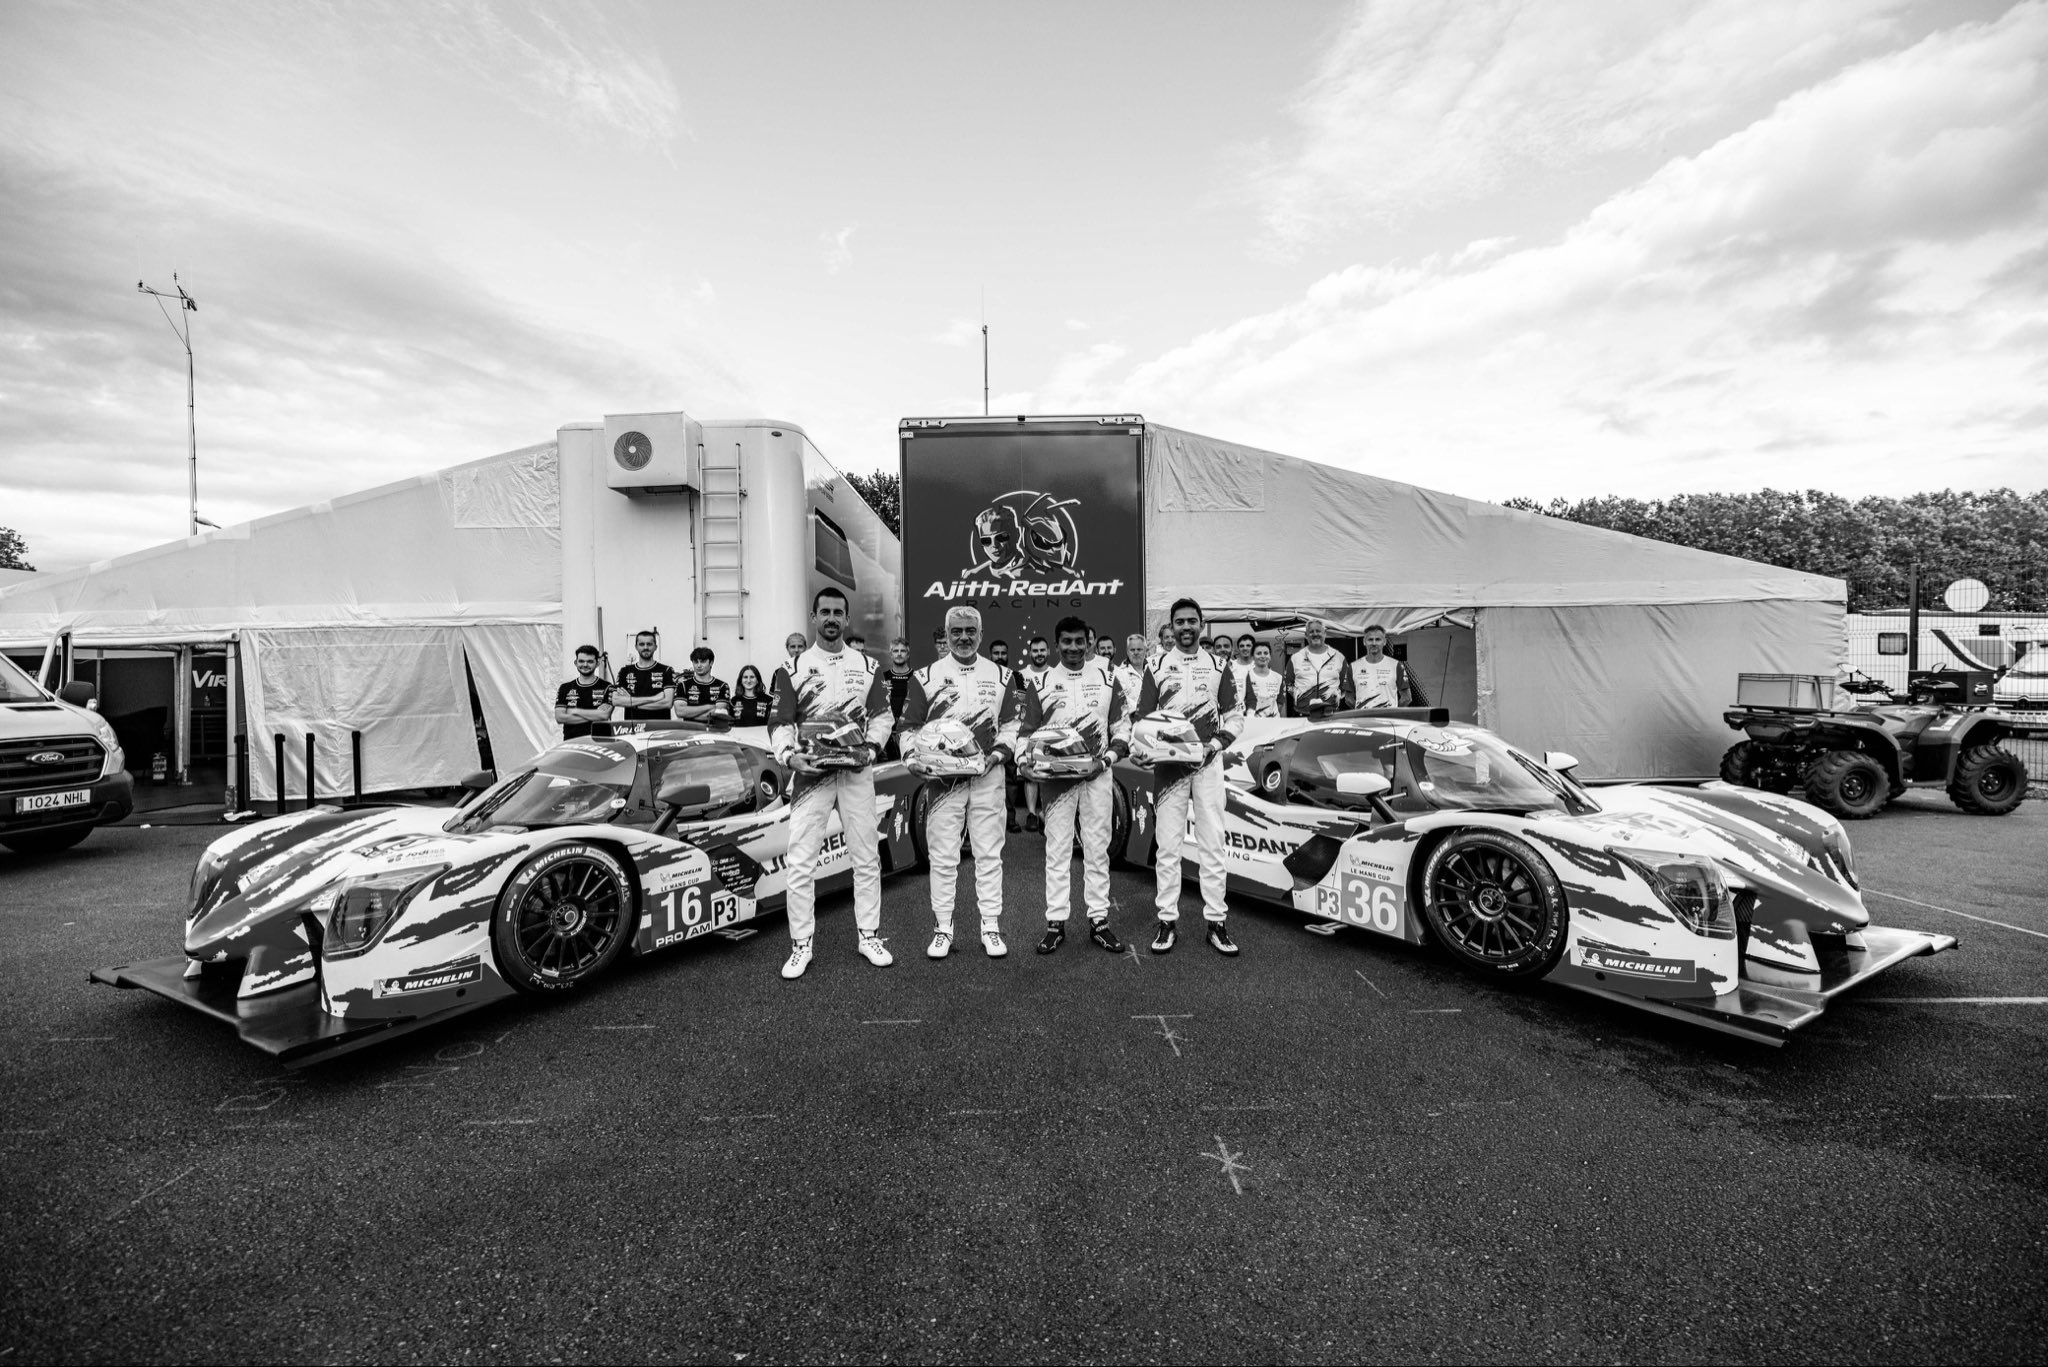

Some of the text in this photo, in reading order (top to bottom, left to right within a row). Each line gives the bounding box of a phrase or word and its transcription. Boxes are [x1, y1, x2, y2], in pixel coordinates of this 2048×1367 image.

[923, 579, 1124, 600] Ajith-RedAnt
[965, 599, 1082, 609] RACING
[41, 752, 59, 762] Ford
[28, 791, 87, 809] 1024 NHL
[534, 847, 583, 871] MICHELIN
[1361, 860, 1394, 872] MICHELIN
[1425, 841, 1449, 886] MICHELIN
[671, 867, 703, 878] MICHELIN
[1359, 869, 1376, 878] MANS
[669, 880, 686, 889] MANS
[688, 877, 700, 885] CUP
[660, 885, 703, 932] 16
[714, 896, 737, 927] P3
[1317, 888, 1340, 916] P3
[1347, 879, 1398, 932] 36
[655, 923, 711, 948] PRO AM
[1605, 957, 1682, 975] MICHELIN
[404, 970, 474, 990] MICHELIN
